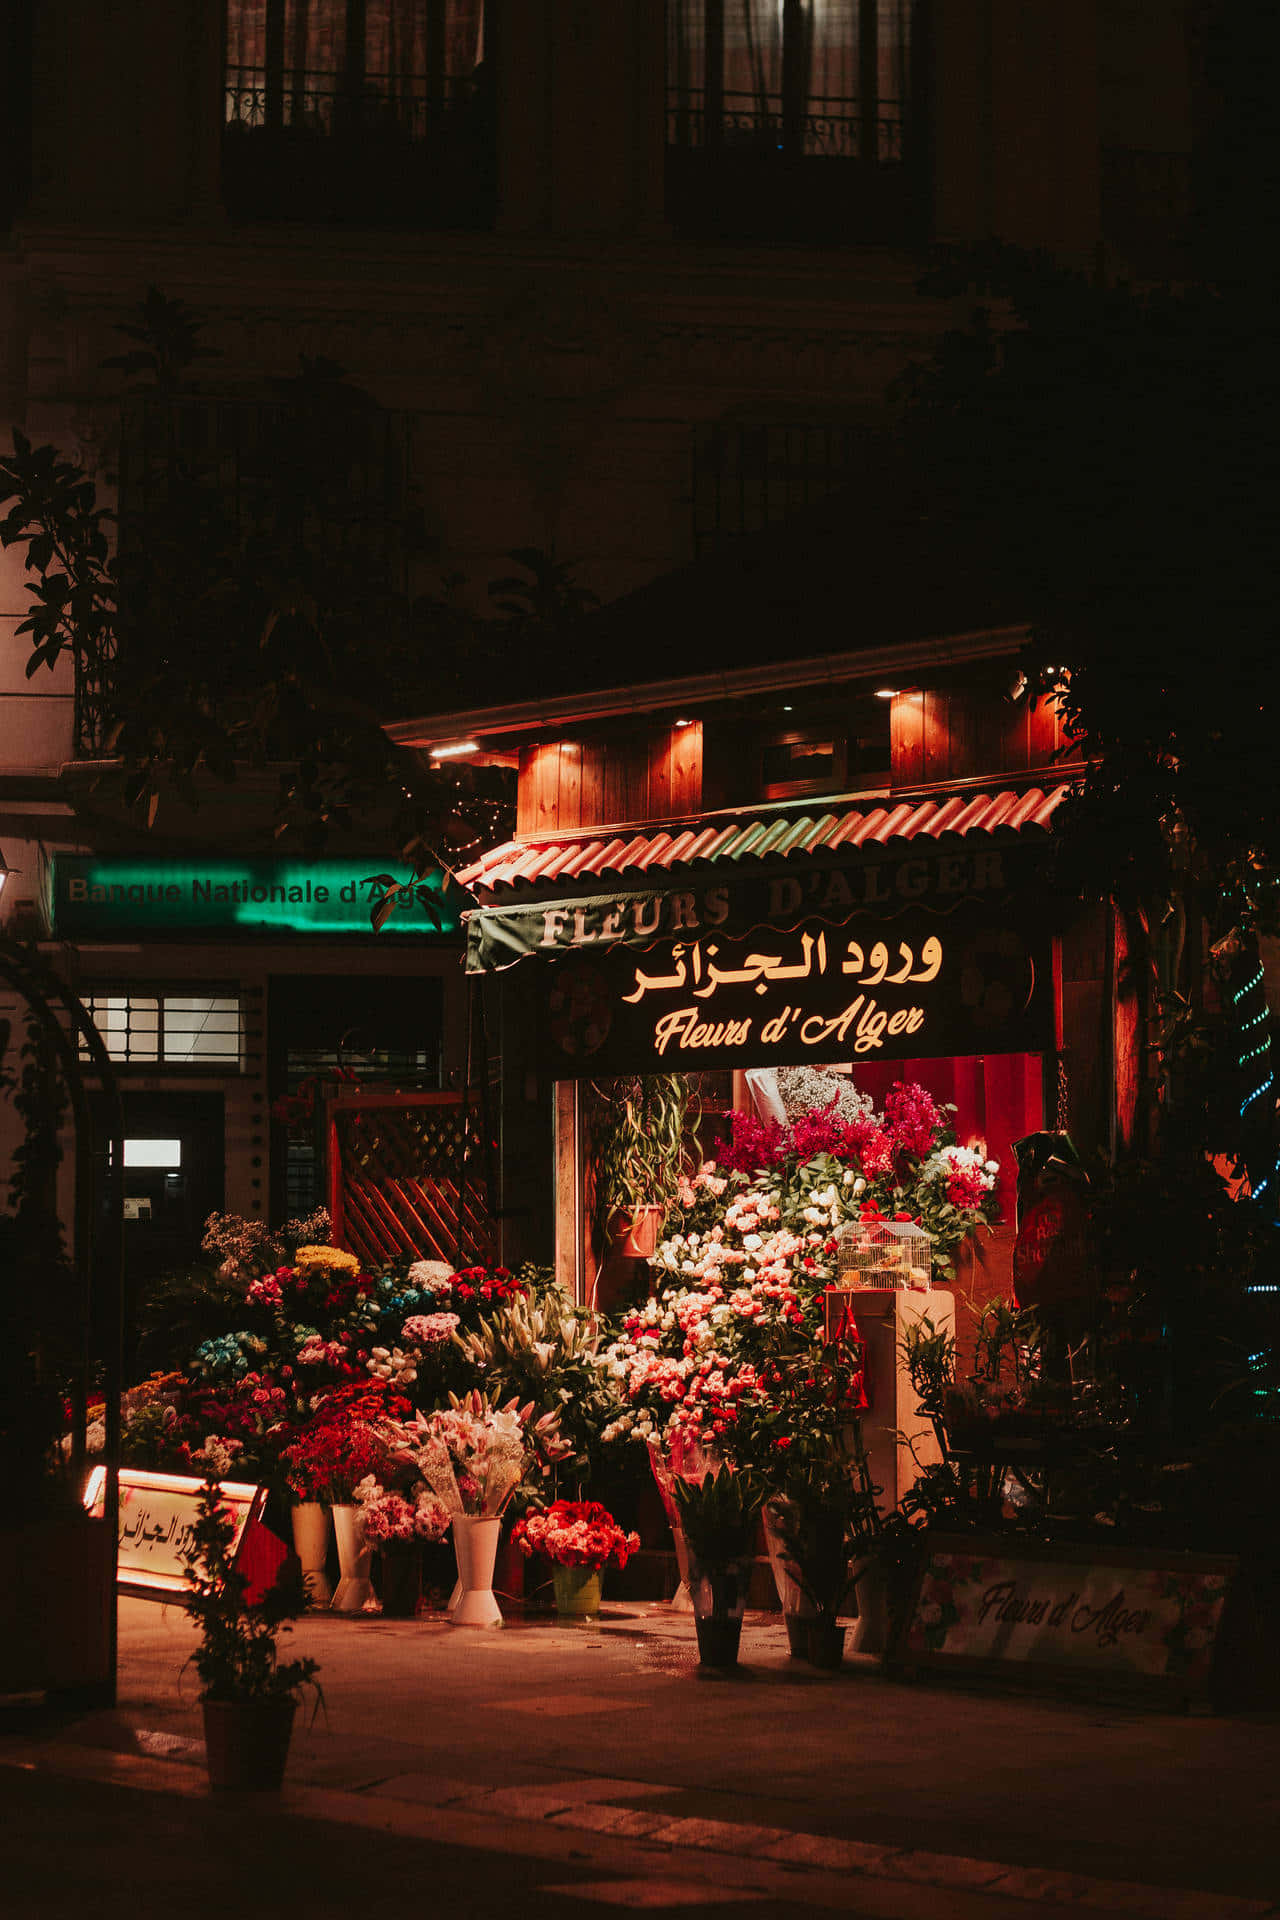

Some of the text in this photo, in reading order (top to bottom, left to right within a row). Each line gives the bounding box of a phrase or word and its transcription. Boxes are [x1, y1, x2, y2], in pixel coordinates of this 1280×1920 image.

[68, 878, 182, 908] Banque
[191, 878, 330, 905] Nationale
[539, 850, 1008, 946] FLEURS D'ALGER
[621, 929, 943, 1004] ورود الجزائر
[654, 1005, 752, 1056] Fleurs
[977, 1580, 1050, 1626] Fleurs
